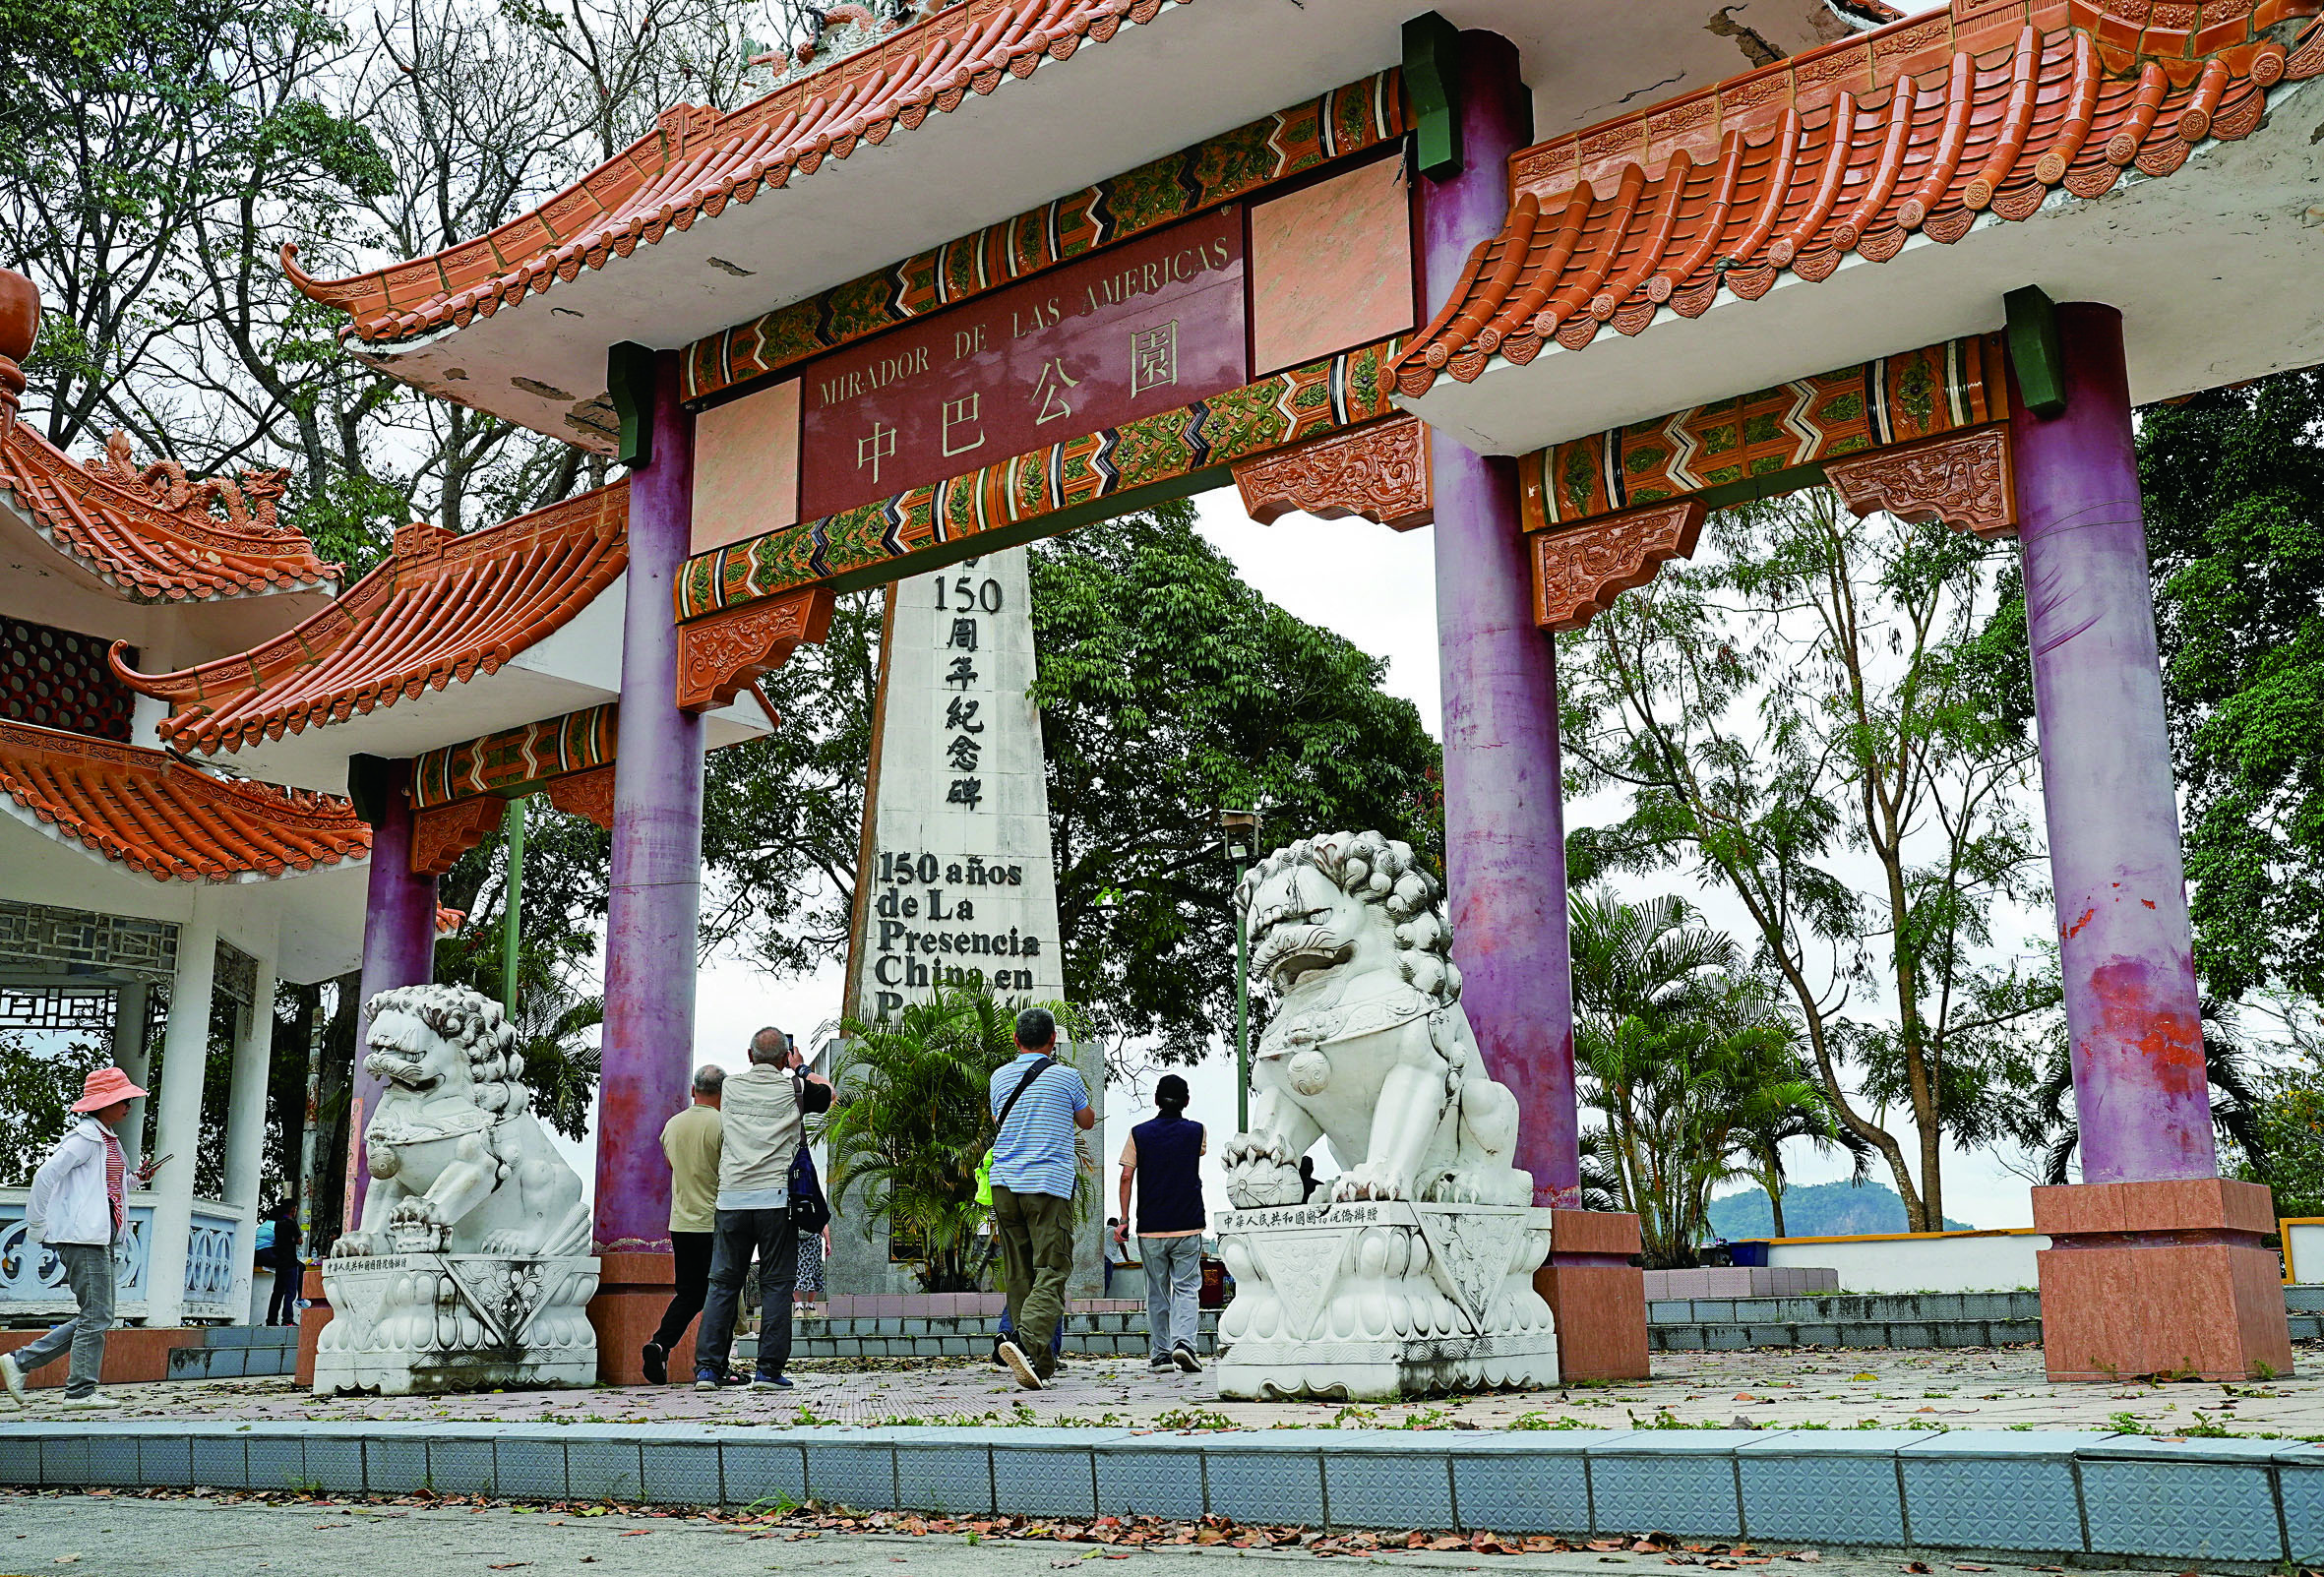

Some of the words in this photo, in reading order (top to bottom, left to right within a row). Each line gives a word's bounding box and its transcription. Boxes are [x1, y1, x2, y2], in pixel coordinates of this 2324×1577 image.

[819, 346, 930, 409] MIRADOR
[953, 324, 987, 361] DE
[1011, 296, 1061, 339] LAS
[1080, 236, 1229, 315] AMERICAS
[935, 576, 1003, 615] 150
[879, 851, 939, 884] 150
[945, 855, 1022, 885] años
[876, 885, 919, 918] de
[927, 888, 974, 921] La
[877, 919, 1040, 955] Presencia
[994, 968, 1034, 990] en
